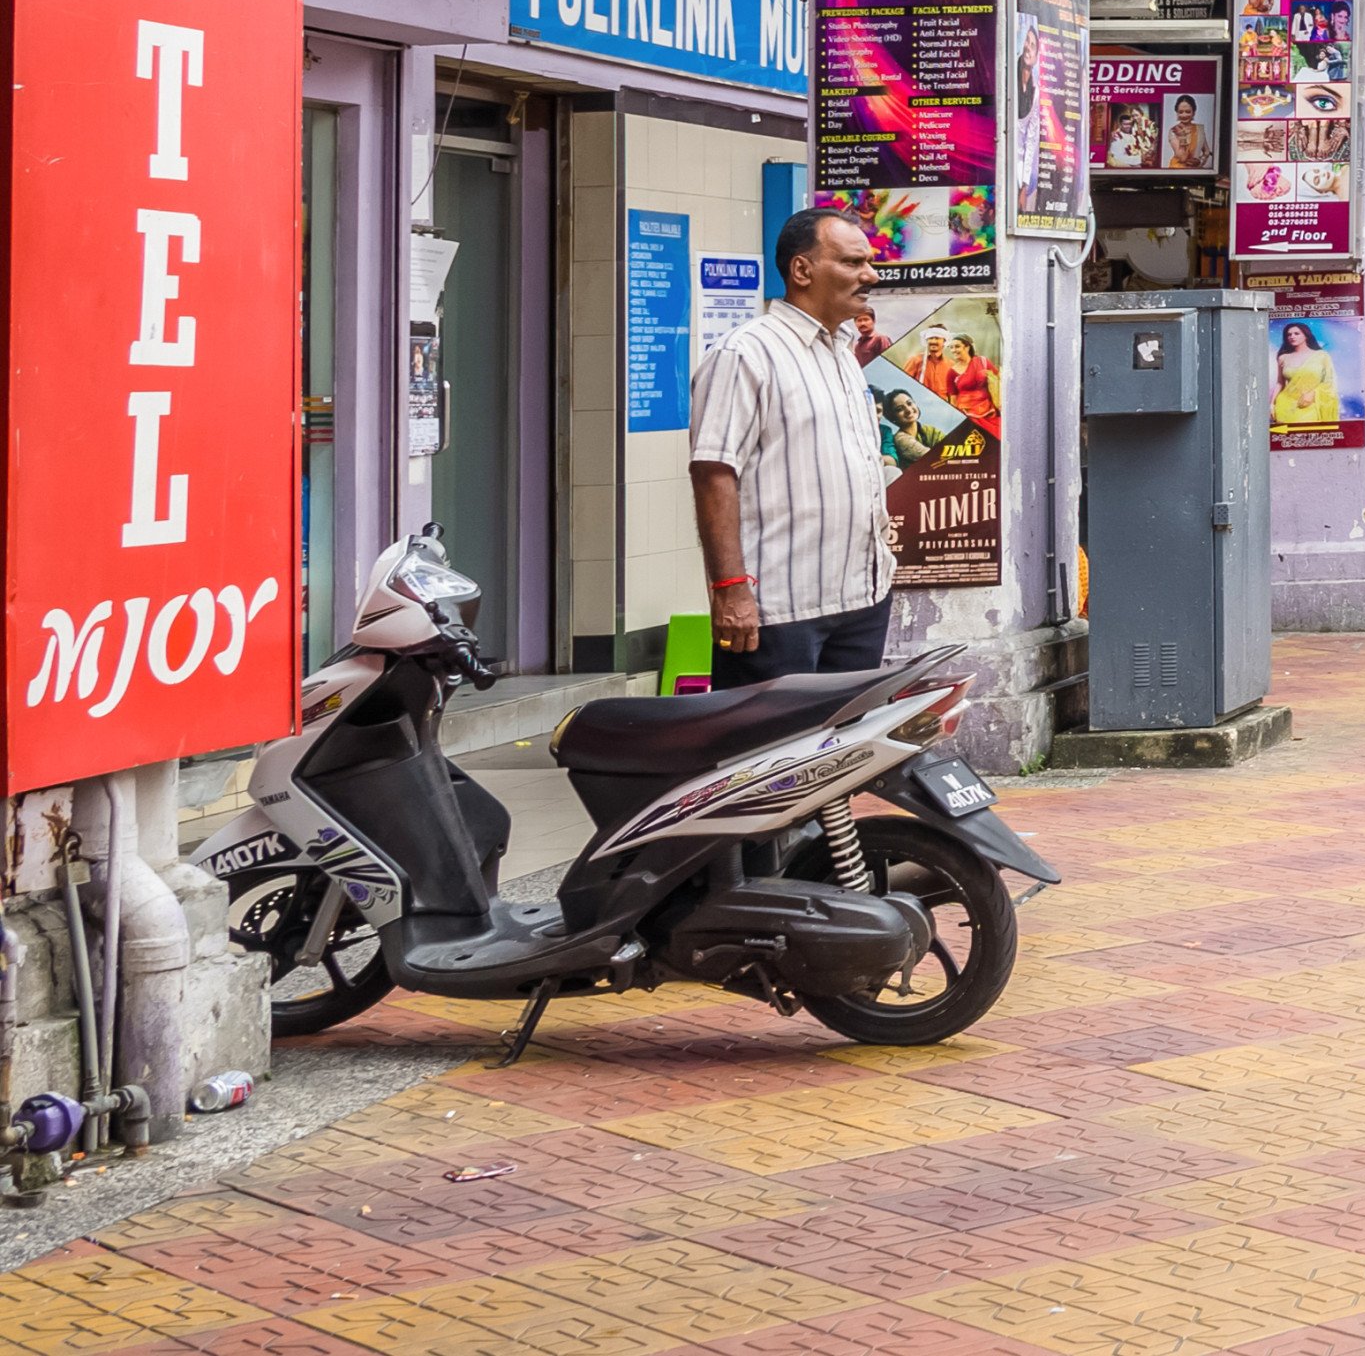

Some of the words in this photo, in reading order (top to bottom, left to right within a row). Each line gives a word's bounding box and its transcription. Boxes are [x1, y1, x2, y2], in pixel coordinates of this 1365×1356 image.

[821, 8, 870, 17] PREWEDDING
[871, 7, 905, 16] PACKAGE
[912, 6, 941, 14] FACIAL
[942, 5, 993, 14] TREATMENTS
[852, 21, 898, 30] Photography
[919, 19, 937, 27] Fruit
[938, 18, 960, 26] Facial
[919, 29, 935, 37] Anti
[919, 40, 945, 48] Normal
[947, 39, 970, 47] Facial
[919, 51, 938, 59] Gold
[939, 50, 960, 58] Facial
[919, 61, 953, 69] Diamond
[953, 60, 975, 68] Facial
[919, 72, 945, 81] Papaya
[946, 71, 968, 79] Facial
[919, 82, 932, 91] Eye
[933, 81, 970, 90] Treatment
[1113, 85, 1155, 94] Services
[821, 88, 859, 96] MAKEUP
[827, 99, 850, 107] Bridal
[912, 97, 941, 106] OTHER
[942, 97, 982, 105] SERVICES
[827, 110, 853, 118] Dinner
[919, 110, 953, 118] Manicure
[827, 121, 843, 130] Day
[919, 121, 951, 129] Pedicure
[821, 134, 862, 143] AVAILABLE
[862, 133, 896, 142] COURSES
[919, 132, 947, 141] Waxing
[828, 146, 852, 155] Beauty
[854, 145, 880, 153] Course
[919, 142, 955, 151] Threading
[849, 155, 879, 165] Draping
[919, 153, 934, 161] Nail
[935, 152, 947, 161] Art
[828, 166, 860, 175] Mehendi
[919, 163, 951, 171] Mehendi
[828, 177, 844, 185] Hair
[845, 177, 871, 186] Styling
[919, 174, 939, 182] Deco
[1261, 227, 1287, 241] 2nd
[1291, 229, 1327, 241] Floor
[704, 262, 738, 278] POLYKLINIK
[910, 266, 958, 279] 014-228
[961, 265, 991, 277] 3228
[1298, 272, 1361, 286] TAILORING
[918, 481, 997, 534] NIMIR
[27, 577, 278, 718] MJOY
[258, 790, 291, 807] YAMAHA
[946, 782, 993, 810] 4107K
